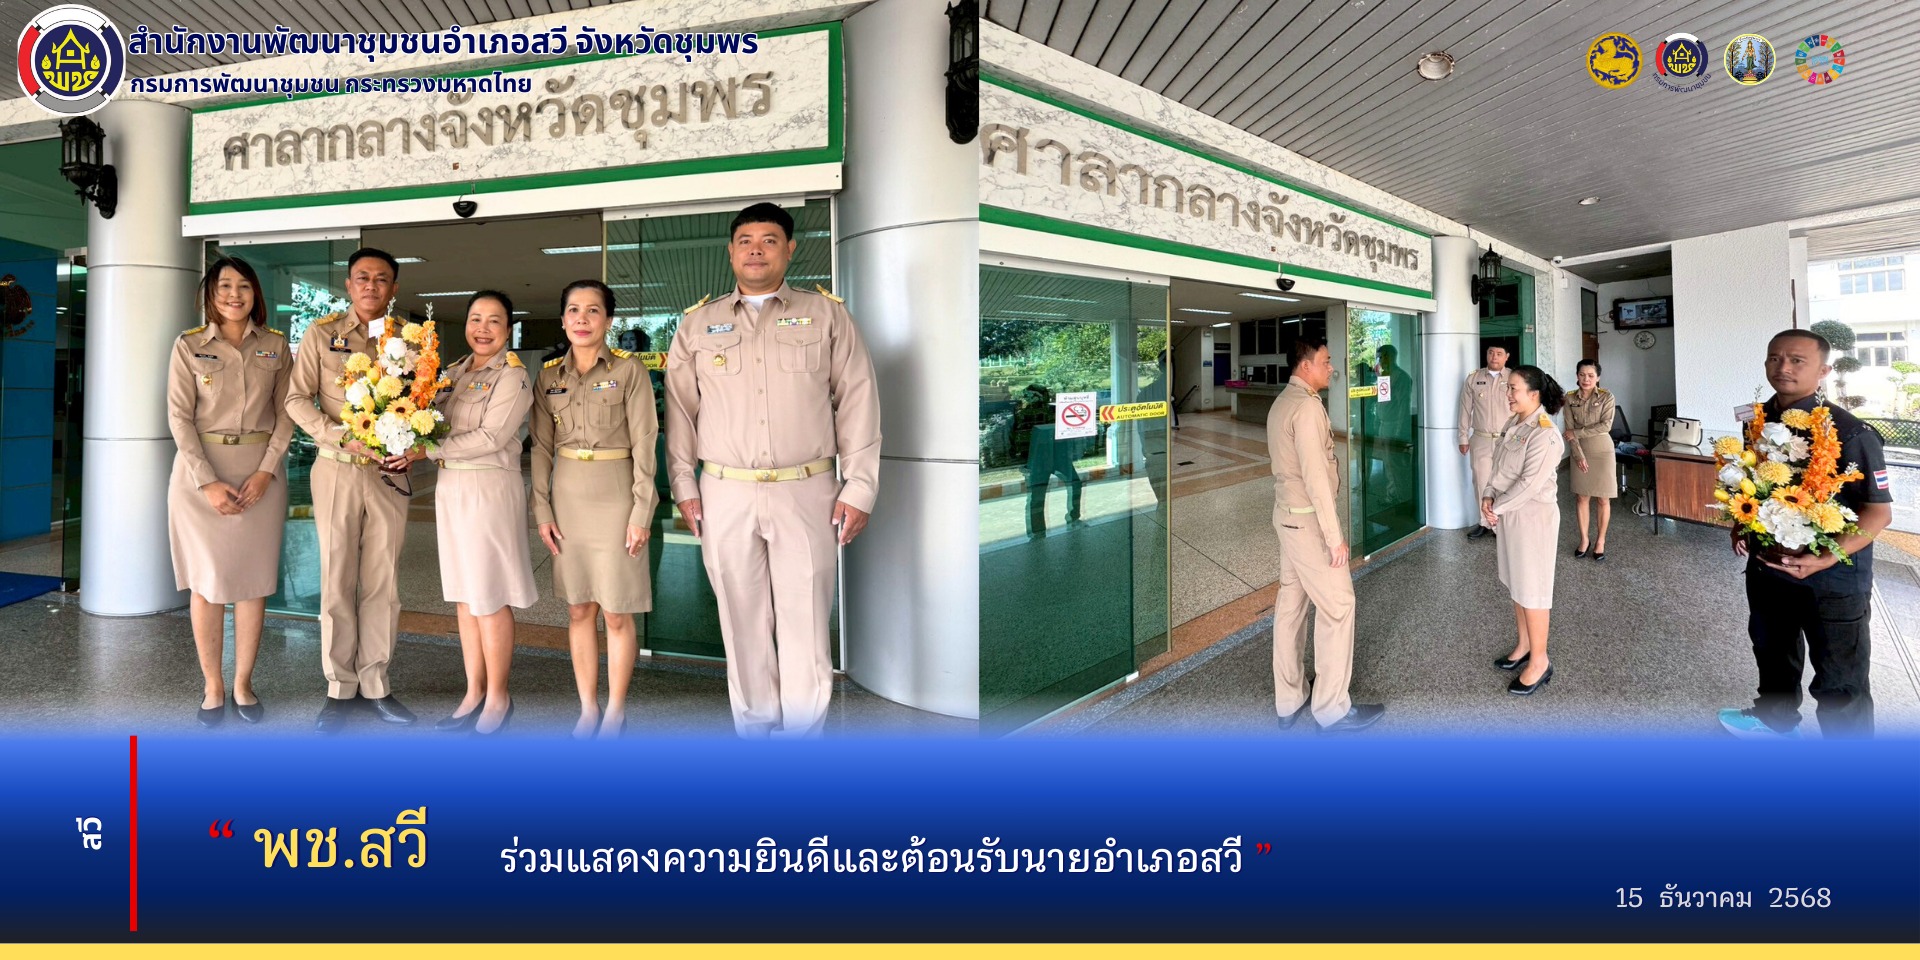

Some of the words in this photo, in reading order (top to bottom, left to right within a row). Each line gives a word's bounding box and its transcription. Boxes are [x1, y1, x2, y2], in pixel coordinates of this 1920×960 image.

[223, 71, 774, 172] ศาลากลางจังหวัดชุมพร
[980, 123, 1419, 274] ศาลากลางจังหวัดชุมพร
